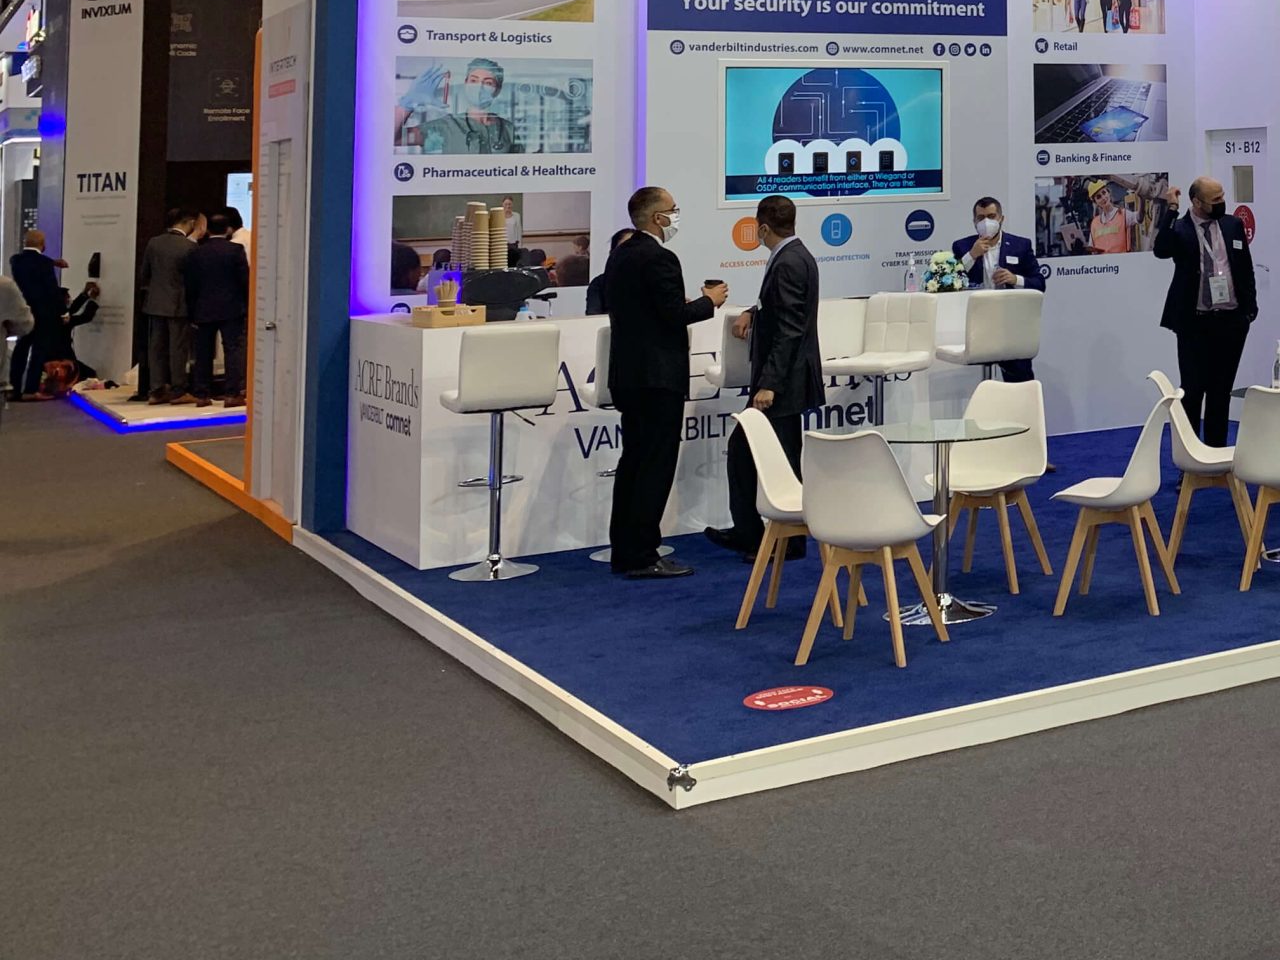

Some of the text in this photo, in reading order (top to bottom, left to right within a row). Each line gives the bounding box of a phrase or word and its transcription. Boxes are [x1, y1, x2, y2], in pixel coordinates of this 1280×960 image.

[81, 3, 132, 19] INVIXIUM
[835, 0, 867, 14] our
[871, 0, 985, 16] commitment
[426, 30, 552, 45] Transport & Logistics
[689, 42, 819, 54] vanderbiltindustries.com
[842, 45, 924, 55] www.comnet.net
[1054, 41, 1078, 51] Retail
[1225, 142, 1236, 153] S1
[1244, 141, 1260, 153] B12
[1055, 152, 1132, 165] Banking & Finance
[423, 164, 596, 178] Pharmaceutical & Healthcare
[803, 173, 828, 182] benefit
[830, 173, 846, 181] from
[847, 173, 867, 181] either
[875, 172, 906, 181] Wiegand
[76, 172, 127, 193] TITAN
[872, 181, 888, 189] They
[837, 253, 870, 262] DETECTION
[895, 250, 938, 258] TRANMISSIO
[720, 260, 745, 268] ACCESS
[1056, 263, 1119, 277] Manufacturing
[355, 358, 419, 408] ACRE Brands
[386, 412, 411, 437] comnet
[574, 413, 732, 459] VABILT
